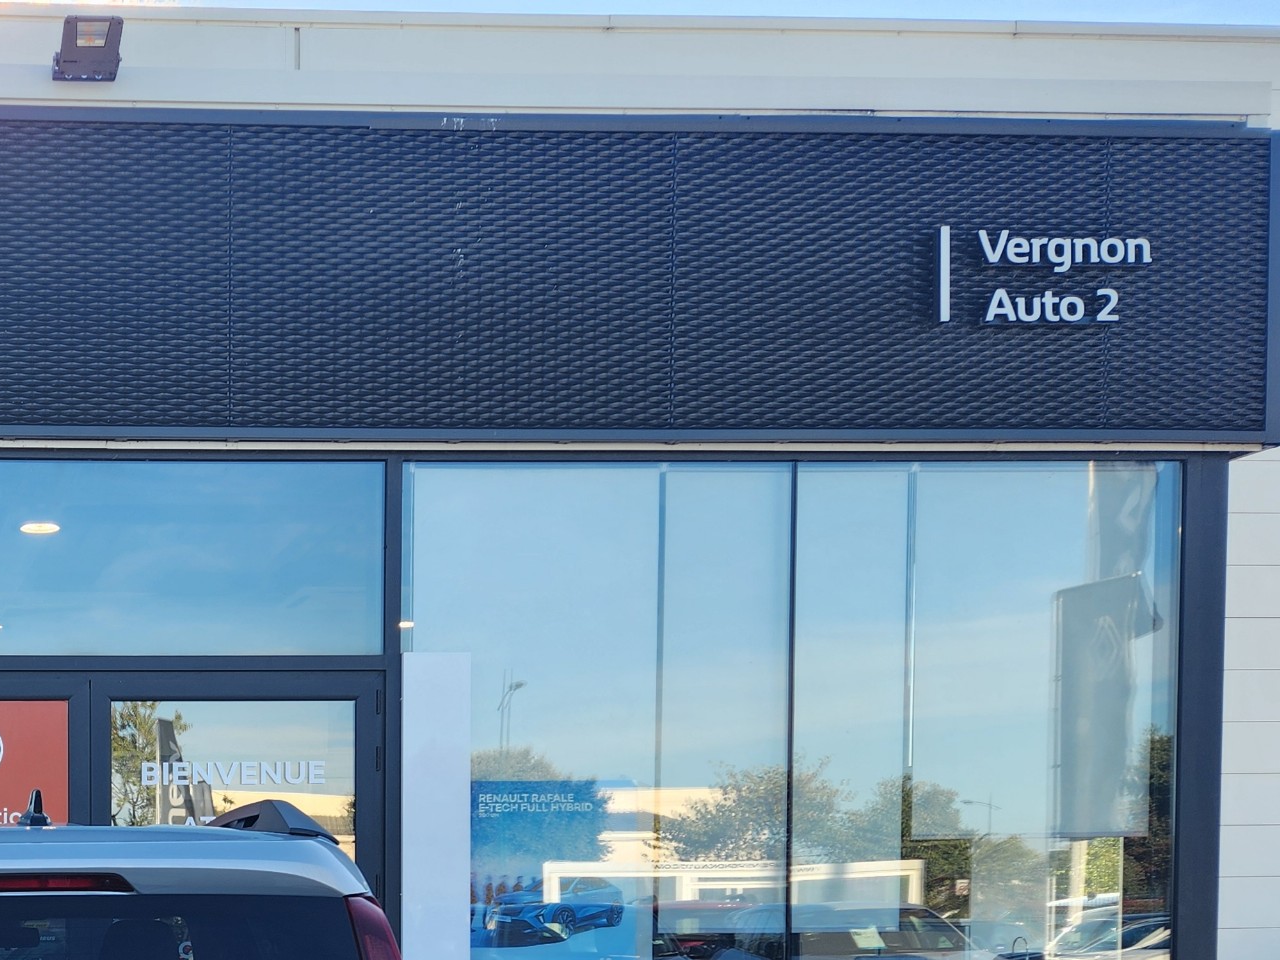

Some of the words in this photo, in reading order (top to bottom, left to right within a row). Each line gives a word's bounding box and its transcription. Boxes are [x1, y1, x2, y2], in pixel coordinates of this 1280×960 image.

[977, 229, 1153, 273] Vergnon
[984, 288, 1085, 322] Auto
[1095, 288, 1120, 322] 2
[141, 760, 326, 786] BIENVENUE
[479, 793, 529, 803] RENAULT
[531, 793, 574, 803] RAFALE
[479, 803, 519, 813] E-TECH
[521, 803, 549, 812] FULL
[551, 802, 593, 812] HYBRID
